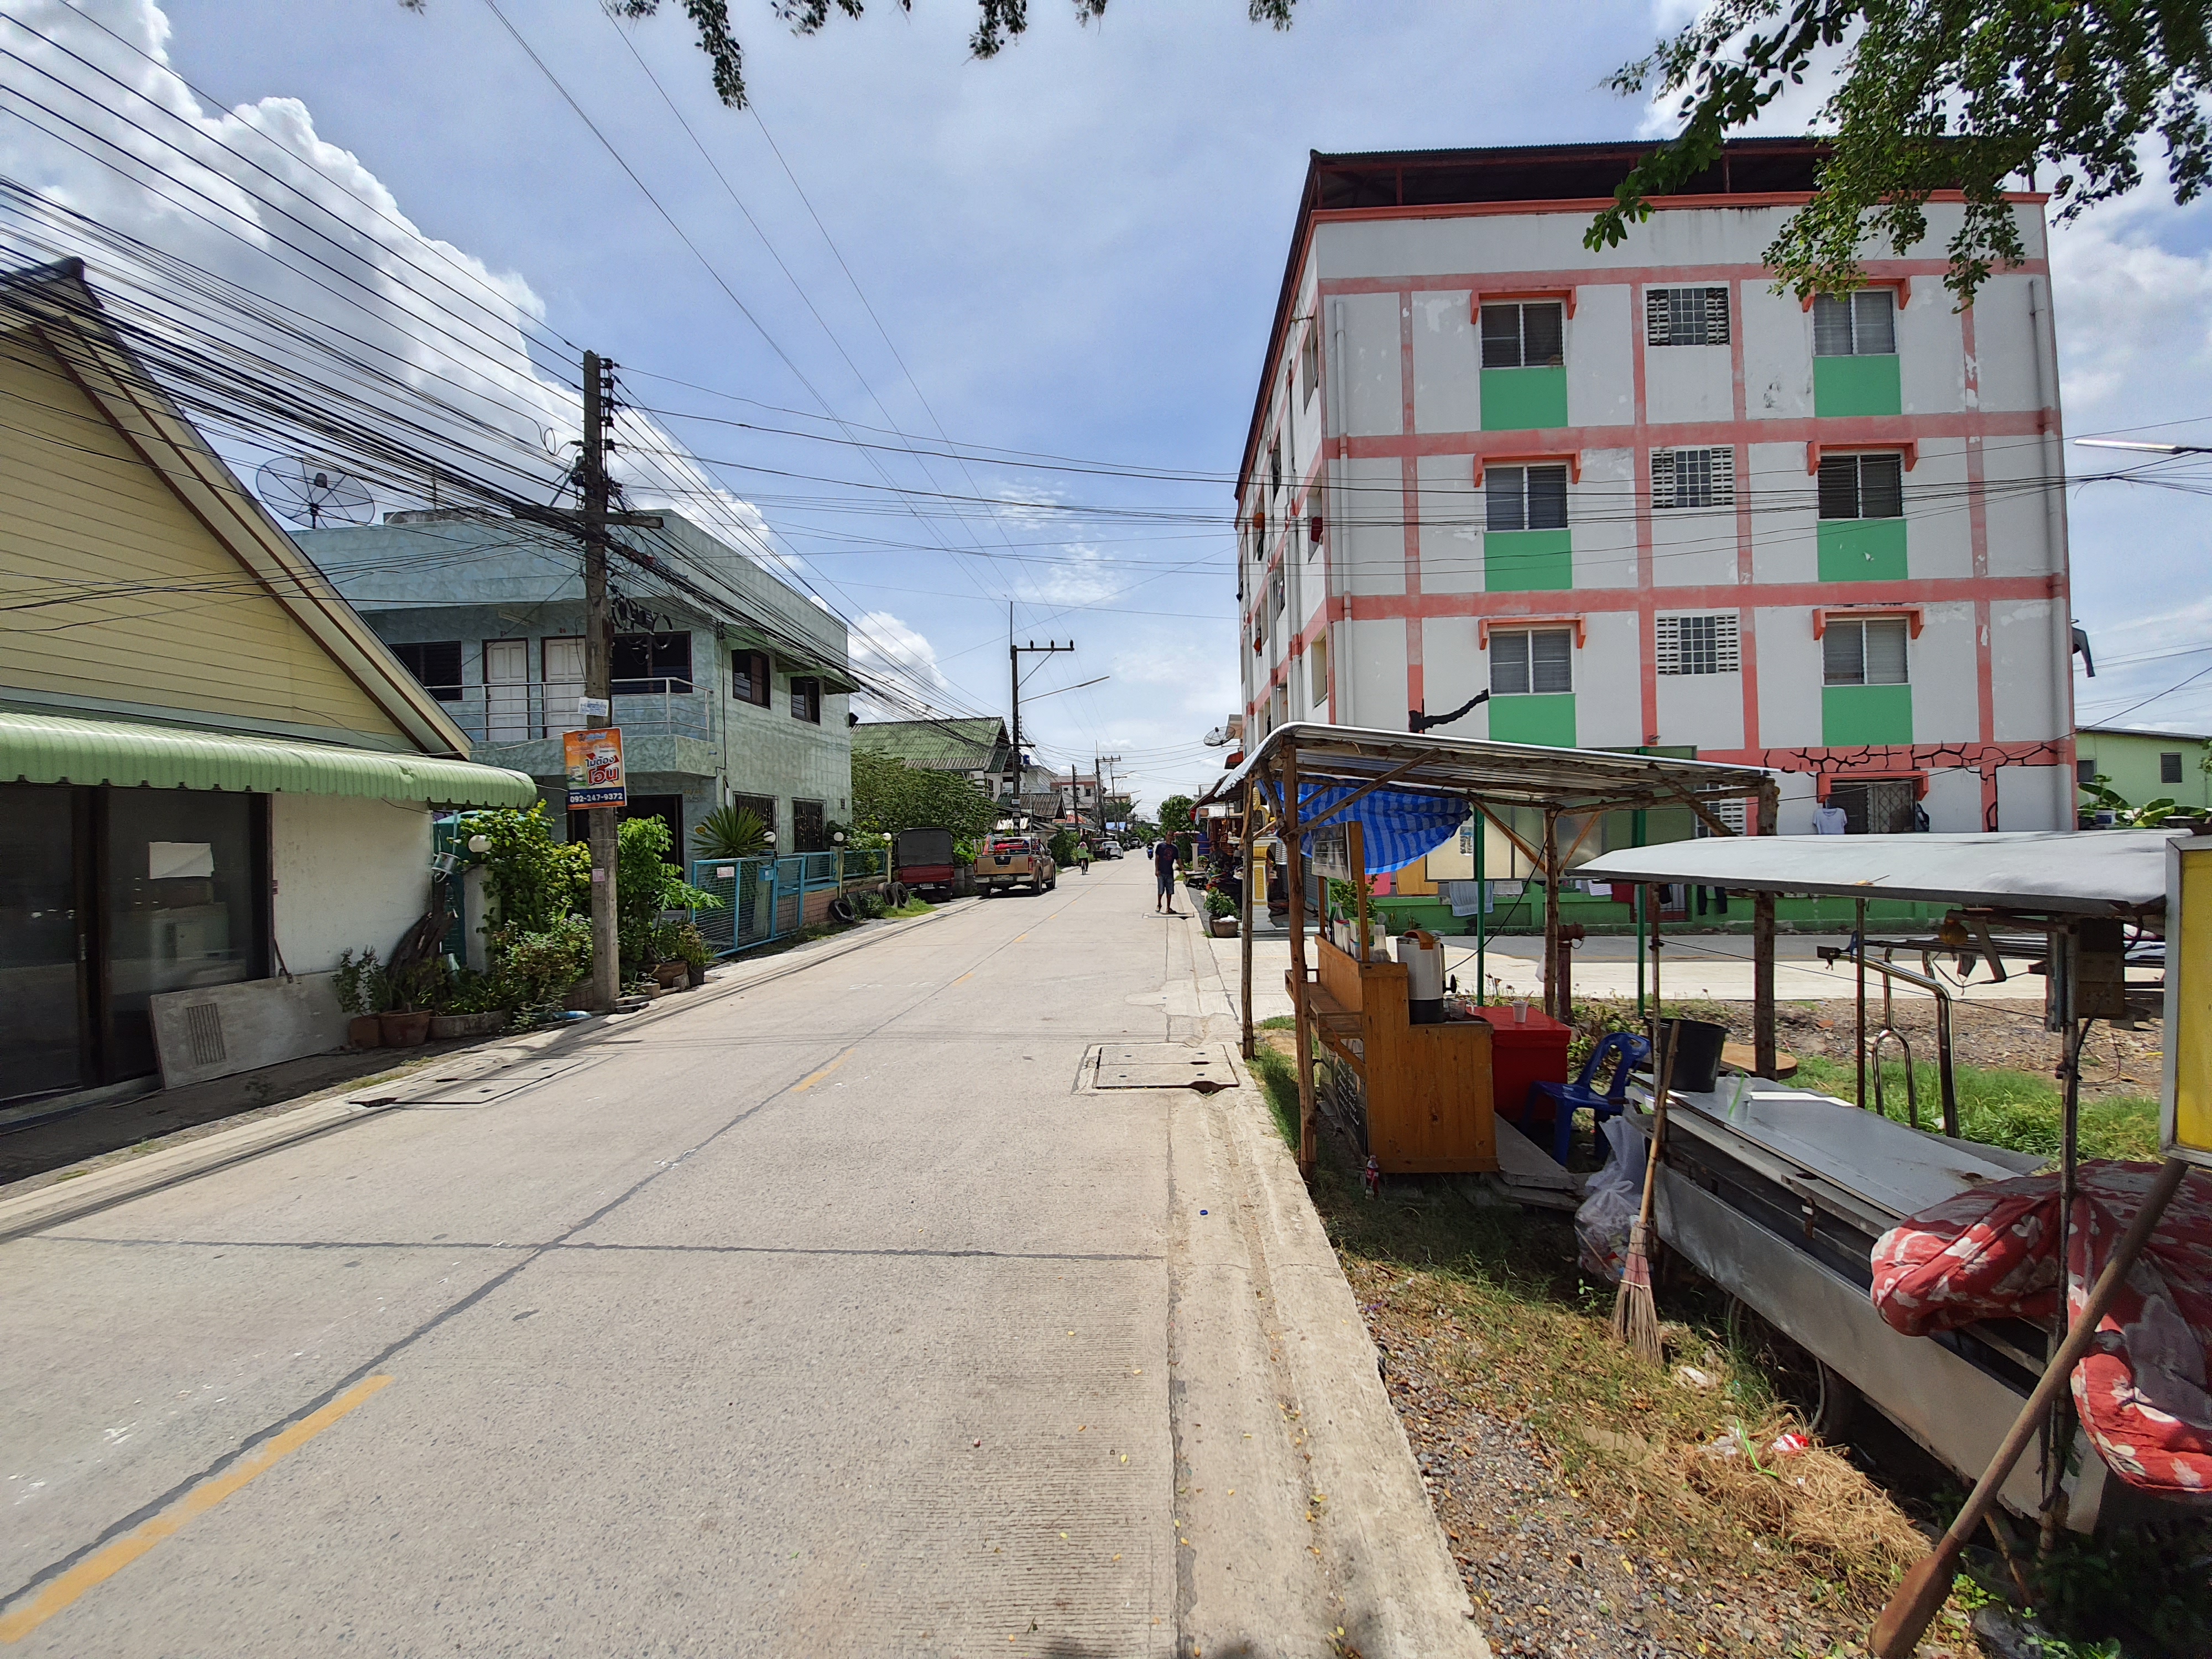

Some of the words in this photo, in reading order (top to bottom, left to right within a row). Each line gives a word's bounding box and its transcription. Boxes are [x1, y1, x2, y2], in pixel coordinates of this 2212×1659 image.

[585, 756, 614, 767] ไม่ต้อง
[587, 767, 619, 785] โอน
[570, 793, 623, 802] 092-247-9372
